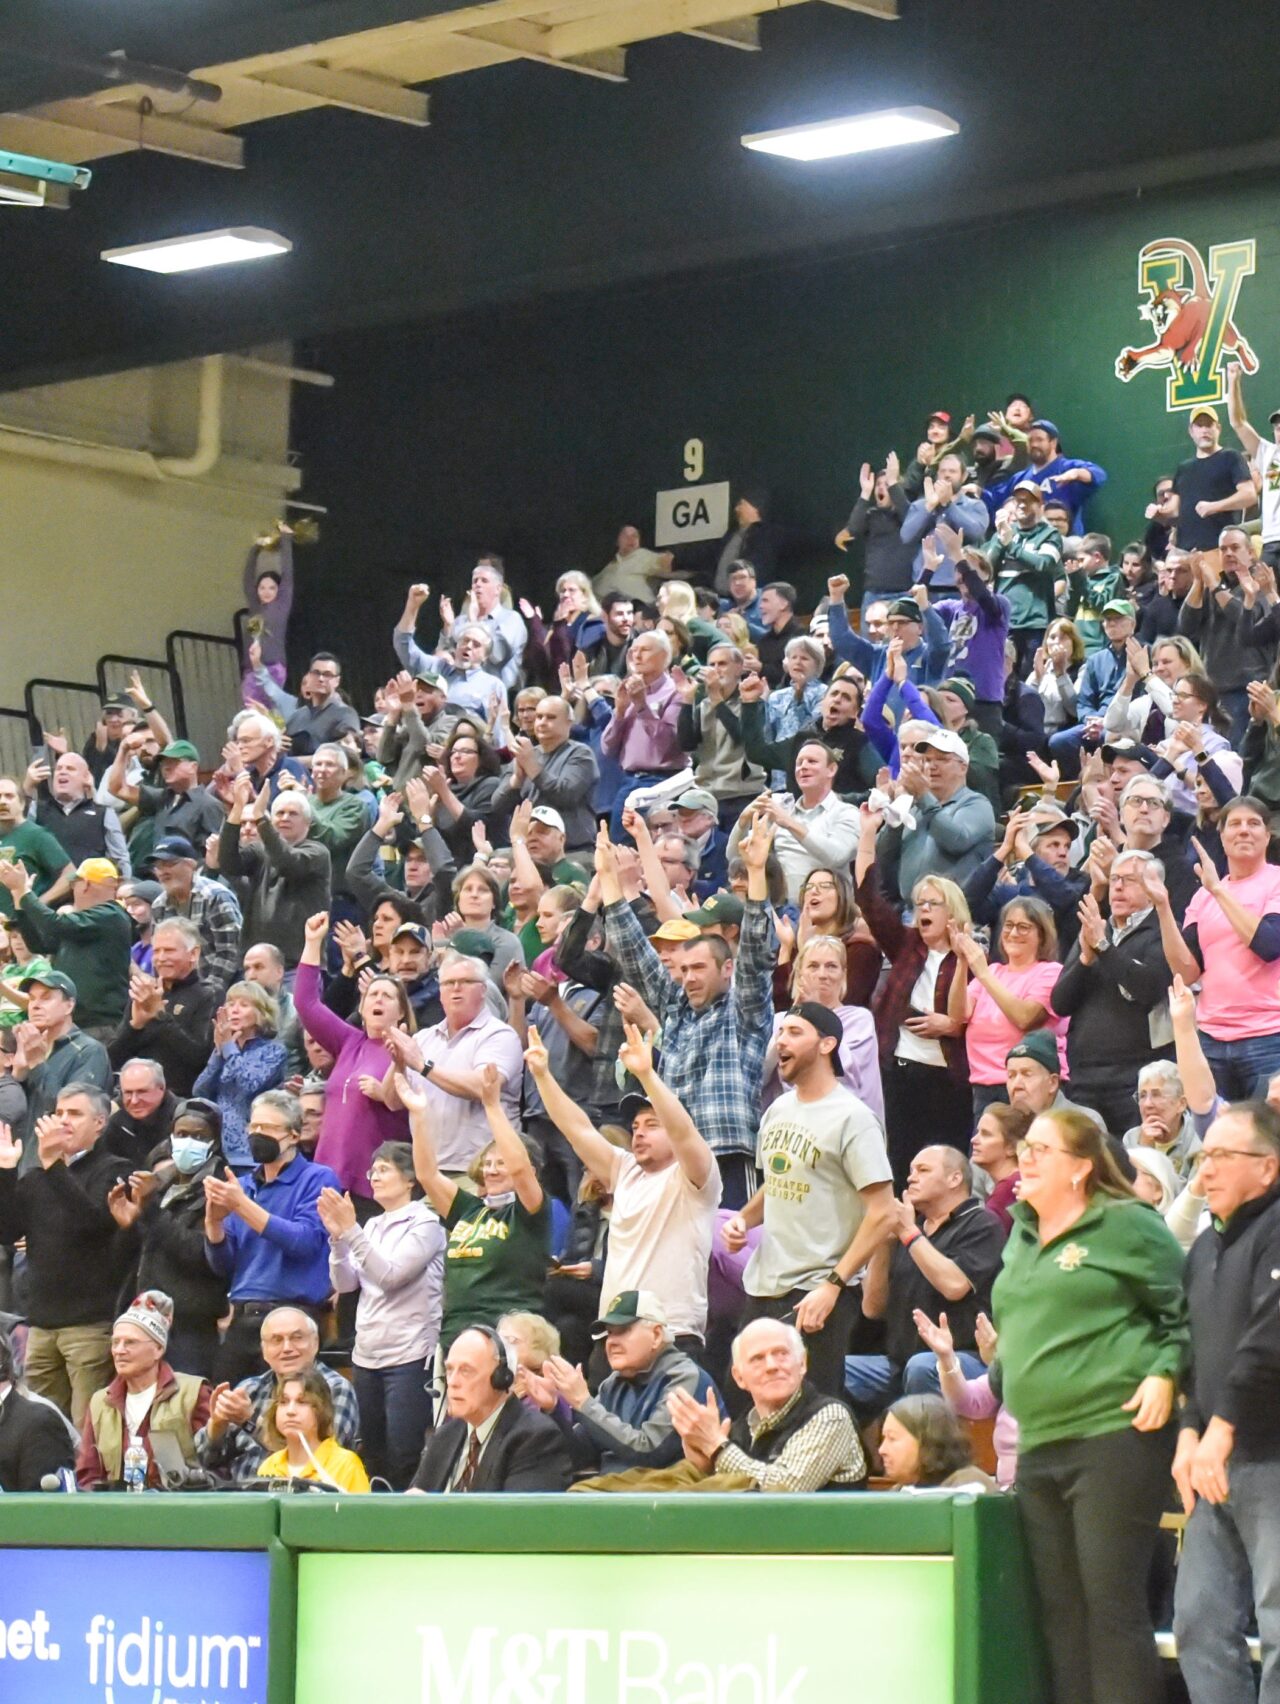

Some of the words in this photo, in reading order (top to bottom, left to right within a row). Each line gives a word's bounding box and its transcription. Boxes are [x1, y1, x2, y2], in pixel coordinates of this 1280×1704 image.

[683, 438, 704, 482] 9
[671, 498, 710, 528] GA
[762, 1129, 822, 1170] ERMONT
[0, 1609, 60, 1661] et.
[416, 1625, 609, 1704] M&T
[618, 1630, 809, 1704] Bank
